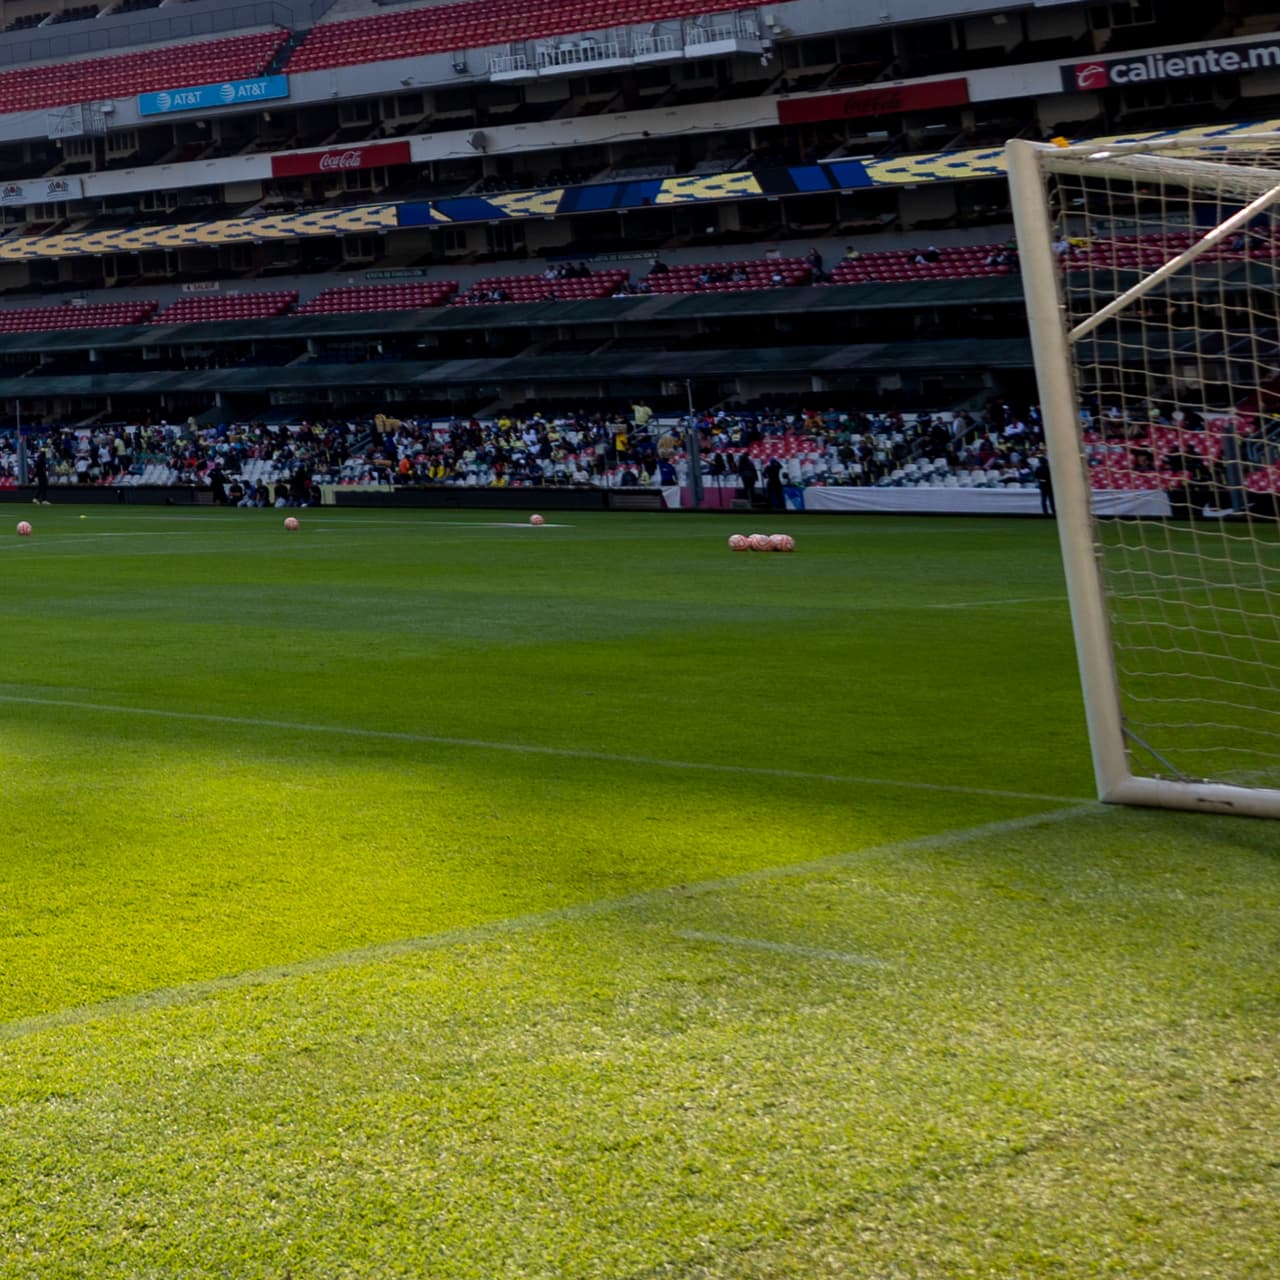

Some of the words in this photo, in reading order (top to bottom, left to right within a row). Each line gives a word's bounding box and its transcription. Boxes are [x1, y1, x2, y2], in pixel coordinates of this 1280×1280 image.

[173, 91, 203, 105] AT&T
[237, 83, 268, 97] AT&T
[319, 151, 362, 171] Coca-Cola
